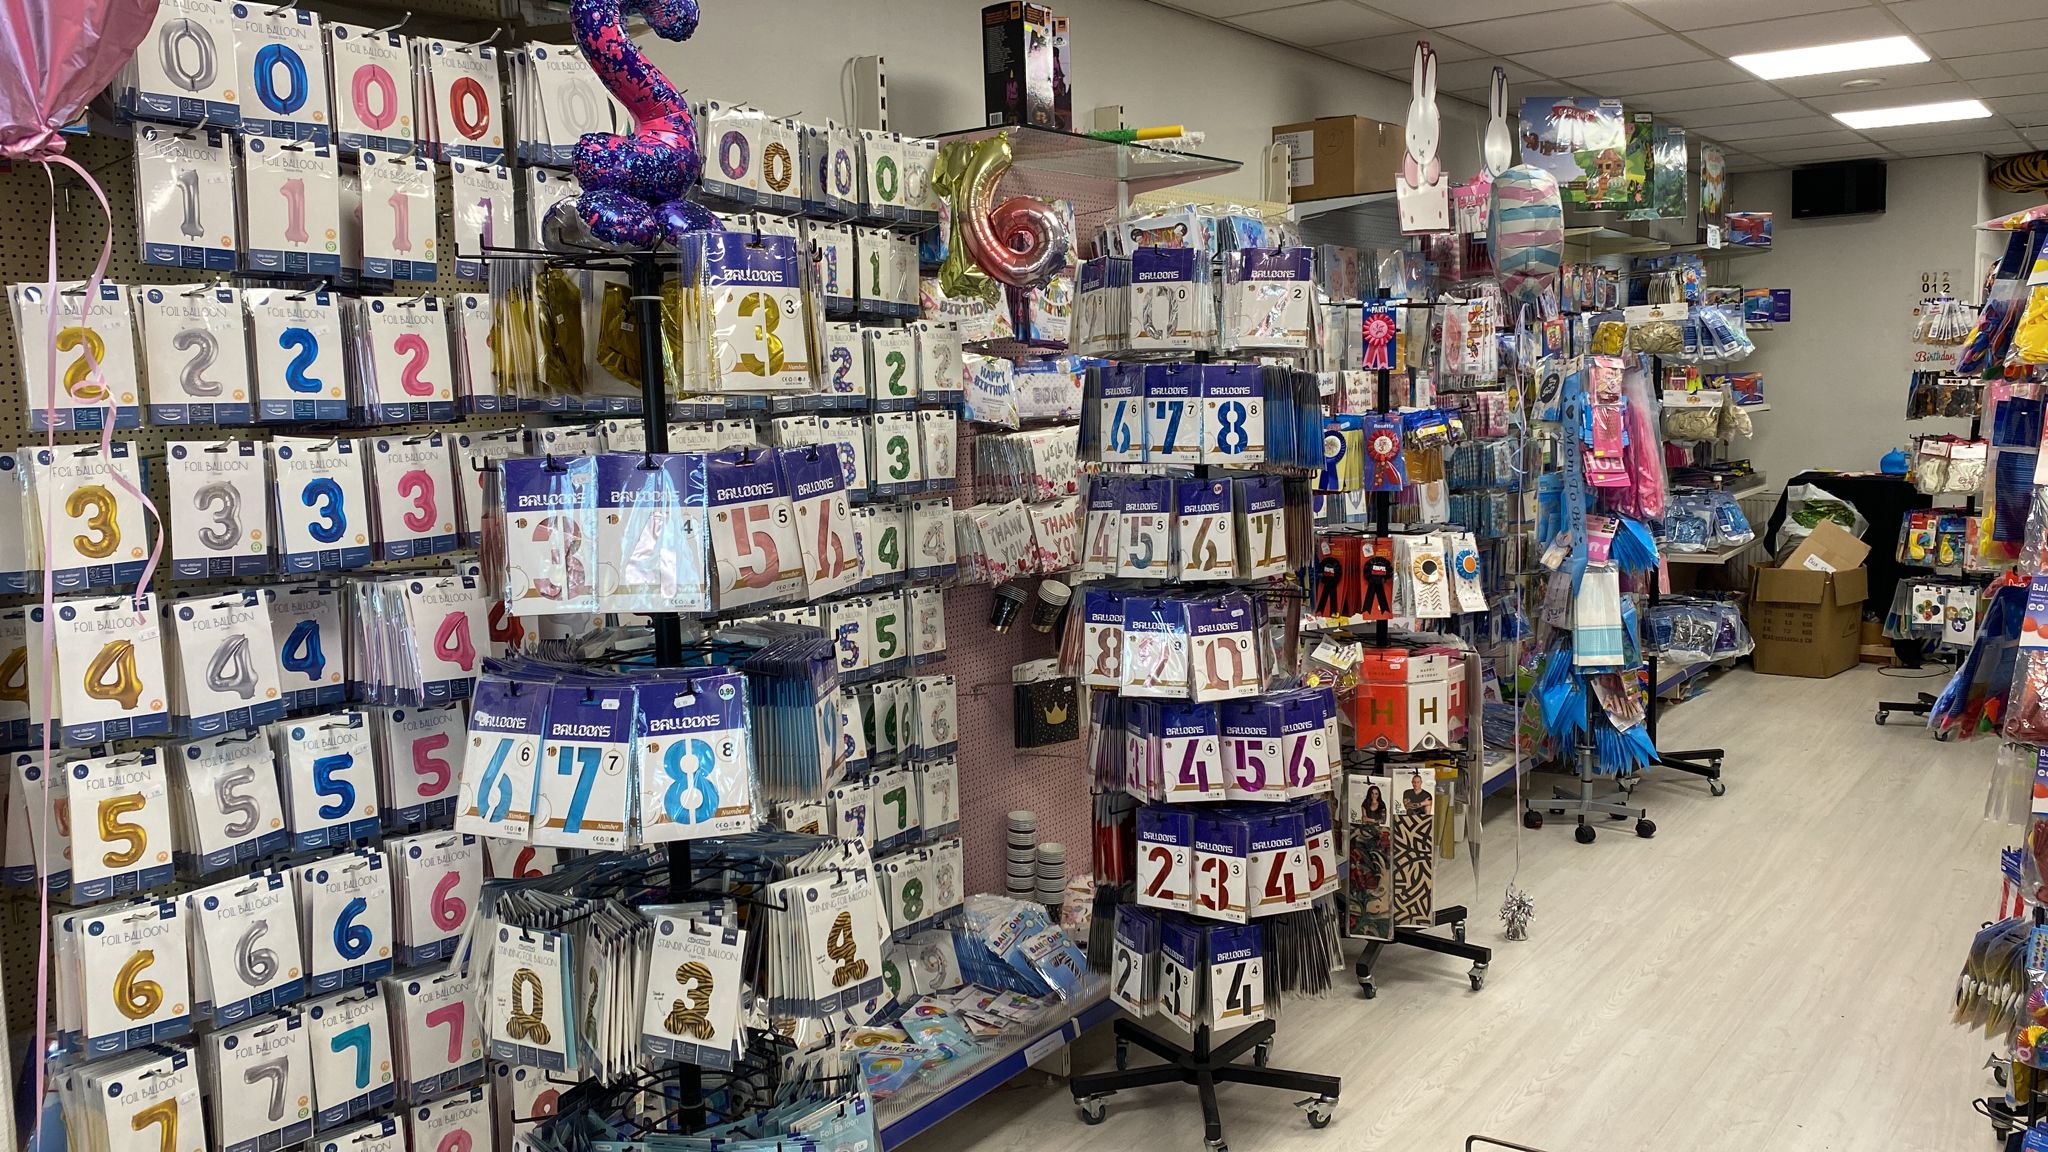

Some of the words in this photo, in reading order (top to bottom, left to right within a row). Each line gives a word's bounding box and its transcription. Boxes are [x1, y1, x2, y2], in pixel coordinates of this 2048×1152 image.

[245, 22, 264, 34] FOIL
[266, 24, 307, 40] BALLOON
[346, 42, 361, 54] FOIL
[364, 45, 397, 60] BALLOON
[1559, 108, 1590, 120] GARLAND
[1139, 270, 1179, 280] BALLOONS
[1251, 270, 1295, 278] BALLOONS
[1922, 272, 1929, 282] 0
[1942, 272, 1949, 282] 2
[1179, 289, 1185, 299] 0
[1294, 288, 1302, 298] 2
[1922, 283, 1929, 293] 0
[1932, 283, 1937, 293] 1
[1943, 283, 1950, 293] 2
[161, 306, 181, 317] FOIL
[183, 306, 227, 317] BALLOON
[268, 307, 283, 317] FOIL
[287, 307, 326, 319] BALLOON
[785, 300, 794, 314] 3
[940, 301, 992, 316] BIRTHDA
[1371, 306, 1388, 314] PARTY
[383, 315, 397, 325] FOIL
[400, 315, 434, 325] BALLOON
[1914, 351, 1955, 365] Birthday
[981, 366, 1005, 383] HAPPY
[975, 376, 1010, 396] BIRTHDAY
[1151, 387, 1188, 395] BALLOONS
[1211, 387, 1251, 395] BALLOONS
[1131, 405, 1137, 414] 6
[1188, 405, 1194, 415] 7
[1251, 405, 1257, 415] 8
[1111, 401, 1131, 453] 6
[1156, 401, 1184, 454] 7
[1217, 401, 1249, 454] 8
[184, 461, 204, 472] FOIL
[206, 461, 249, 472] BALLOON
[291, 460, 306, 470] FOIL
[310, 459, 348, 470] BALLOON
[717, 483, 773, 500] BALLOONS
[797, 477, 833, 496] BALLOONS
[519, 492, 585, 506] BALLOONS
[837, 505, 845, 516] 6
[1126, 503, 1158, 511] BALLOONS
[1184, 503, 1219, 513] BALLOONS
[1251, 500, 1276, 511] BALLOONS
[778, 510, 787, 523] 5
[1276, 516, 1281, 526] 7
[1041, 511, 1075, 536] THAN
[1110, 519, 1116, 527] 4
[1157, 521, 1163, 530] 5
[1219, 521, 1225, 530] 6
[988, 514, 1025, 547] THANK
[818, 499, 843, 578] 6
[1130, 517, 1154, 569] 5
[1192, 518, 1218, 571] 6
[730, 505, 780, 588] 5
[1001, 539, 1025, 565] YOU
[74, 621, 94, 633] FOIL
[97, 617, 140, 630] BALLOON
[193, 620, 211, 631] FOIL
[214, 613, 254, 629] BALLOON
[1132, 621, 1175, 630] BALLOONS
[1198, 622, 1238, 633] BALLOONS
[1240, 639, 1247, 649] 0
[719, 687, 734, 696] 0,99
[1370, 698, 1393, 725] H
[1419, 696, 1438, 725] H
[651, 714, 720, 731] BALLOONS
[553, 724, 610, 737] BALLOONS
[1166, 726, 1204, 735] BALLOONS
[1226, 726, 1267, 735] BALLOONS
[1328, 725, 1333, 734] 7
[1314, 737, 1321, 746] 6
[723, 742, 732, 756] 8
[1206, 743, 1213, 753] 4
[1268, 745, 1275, 755] 5
[521, 748, 530, 761] 6
[609, 756, 618, 770] 7
[1179, 739, 1209, 792] 4
[1234, 740, 1266, 792] 5
[1289, 735, 1316, 788] 6
[86, 779, 106, 790] FOIL
[109, 771, 151, 787] BALLOON
[477, 738, 513, 822] 6
[663, 738, 719, 825] 8
[558, 746, 602, 833] 7
[721, 807, 746, 816] Number
[597, 823, 619, 831] Number
[1143, 832, 1177, 843] BALLOONS
[1196, 841, 1233, 854] BALLOONS
[1252, 838, 1293, 850] BALLOONS
[1324, 840, 1330, 848] 5
[420, 859, 434, 868] FOIL
[437, 849, 471, 865] BALLOON
[1177, 854, 1183, 863] 2
[1294, 855, 1301, 864] 4
[1149, 847, 1174, 899] 2
[1233, 865, 1240, 875] 3
[1265, 851, 1296, 904] 4
[1200, 858, 1229, 911] 3
[217, 908, 236, 920] FOIL
[238, 894, 279, 914] BALLOON
[101, 934, 122, 947] FOIL
[124, 924, 169, 942] BALLOON
[1217, 949, 1251, 961] BALLOONS
[1134, 960, 1138, 970] 2
[1251, 966, 1258, 975] 4
[1183, 975, 1188, 985] 3
[1226, 963, 1251, 1016] 4
[236, 1047, 253, 1059] FOIL
[256, 1034, 296, 1053] BALLOON
[121, 1094, 140, 1106] FOIL
[142, 1075, 183, 1099] BALLOON
